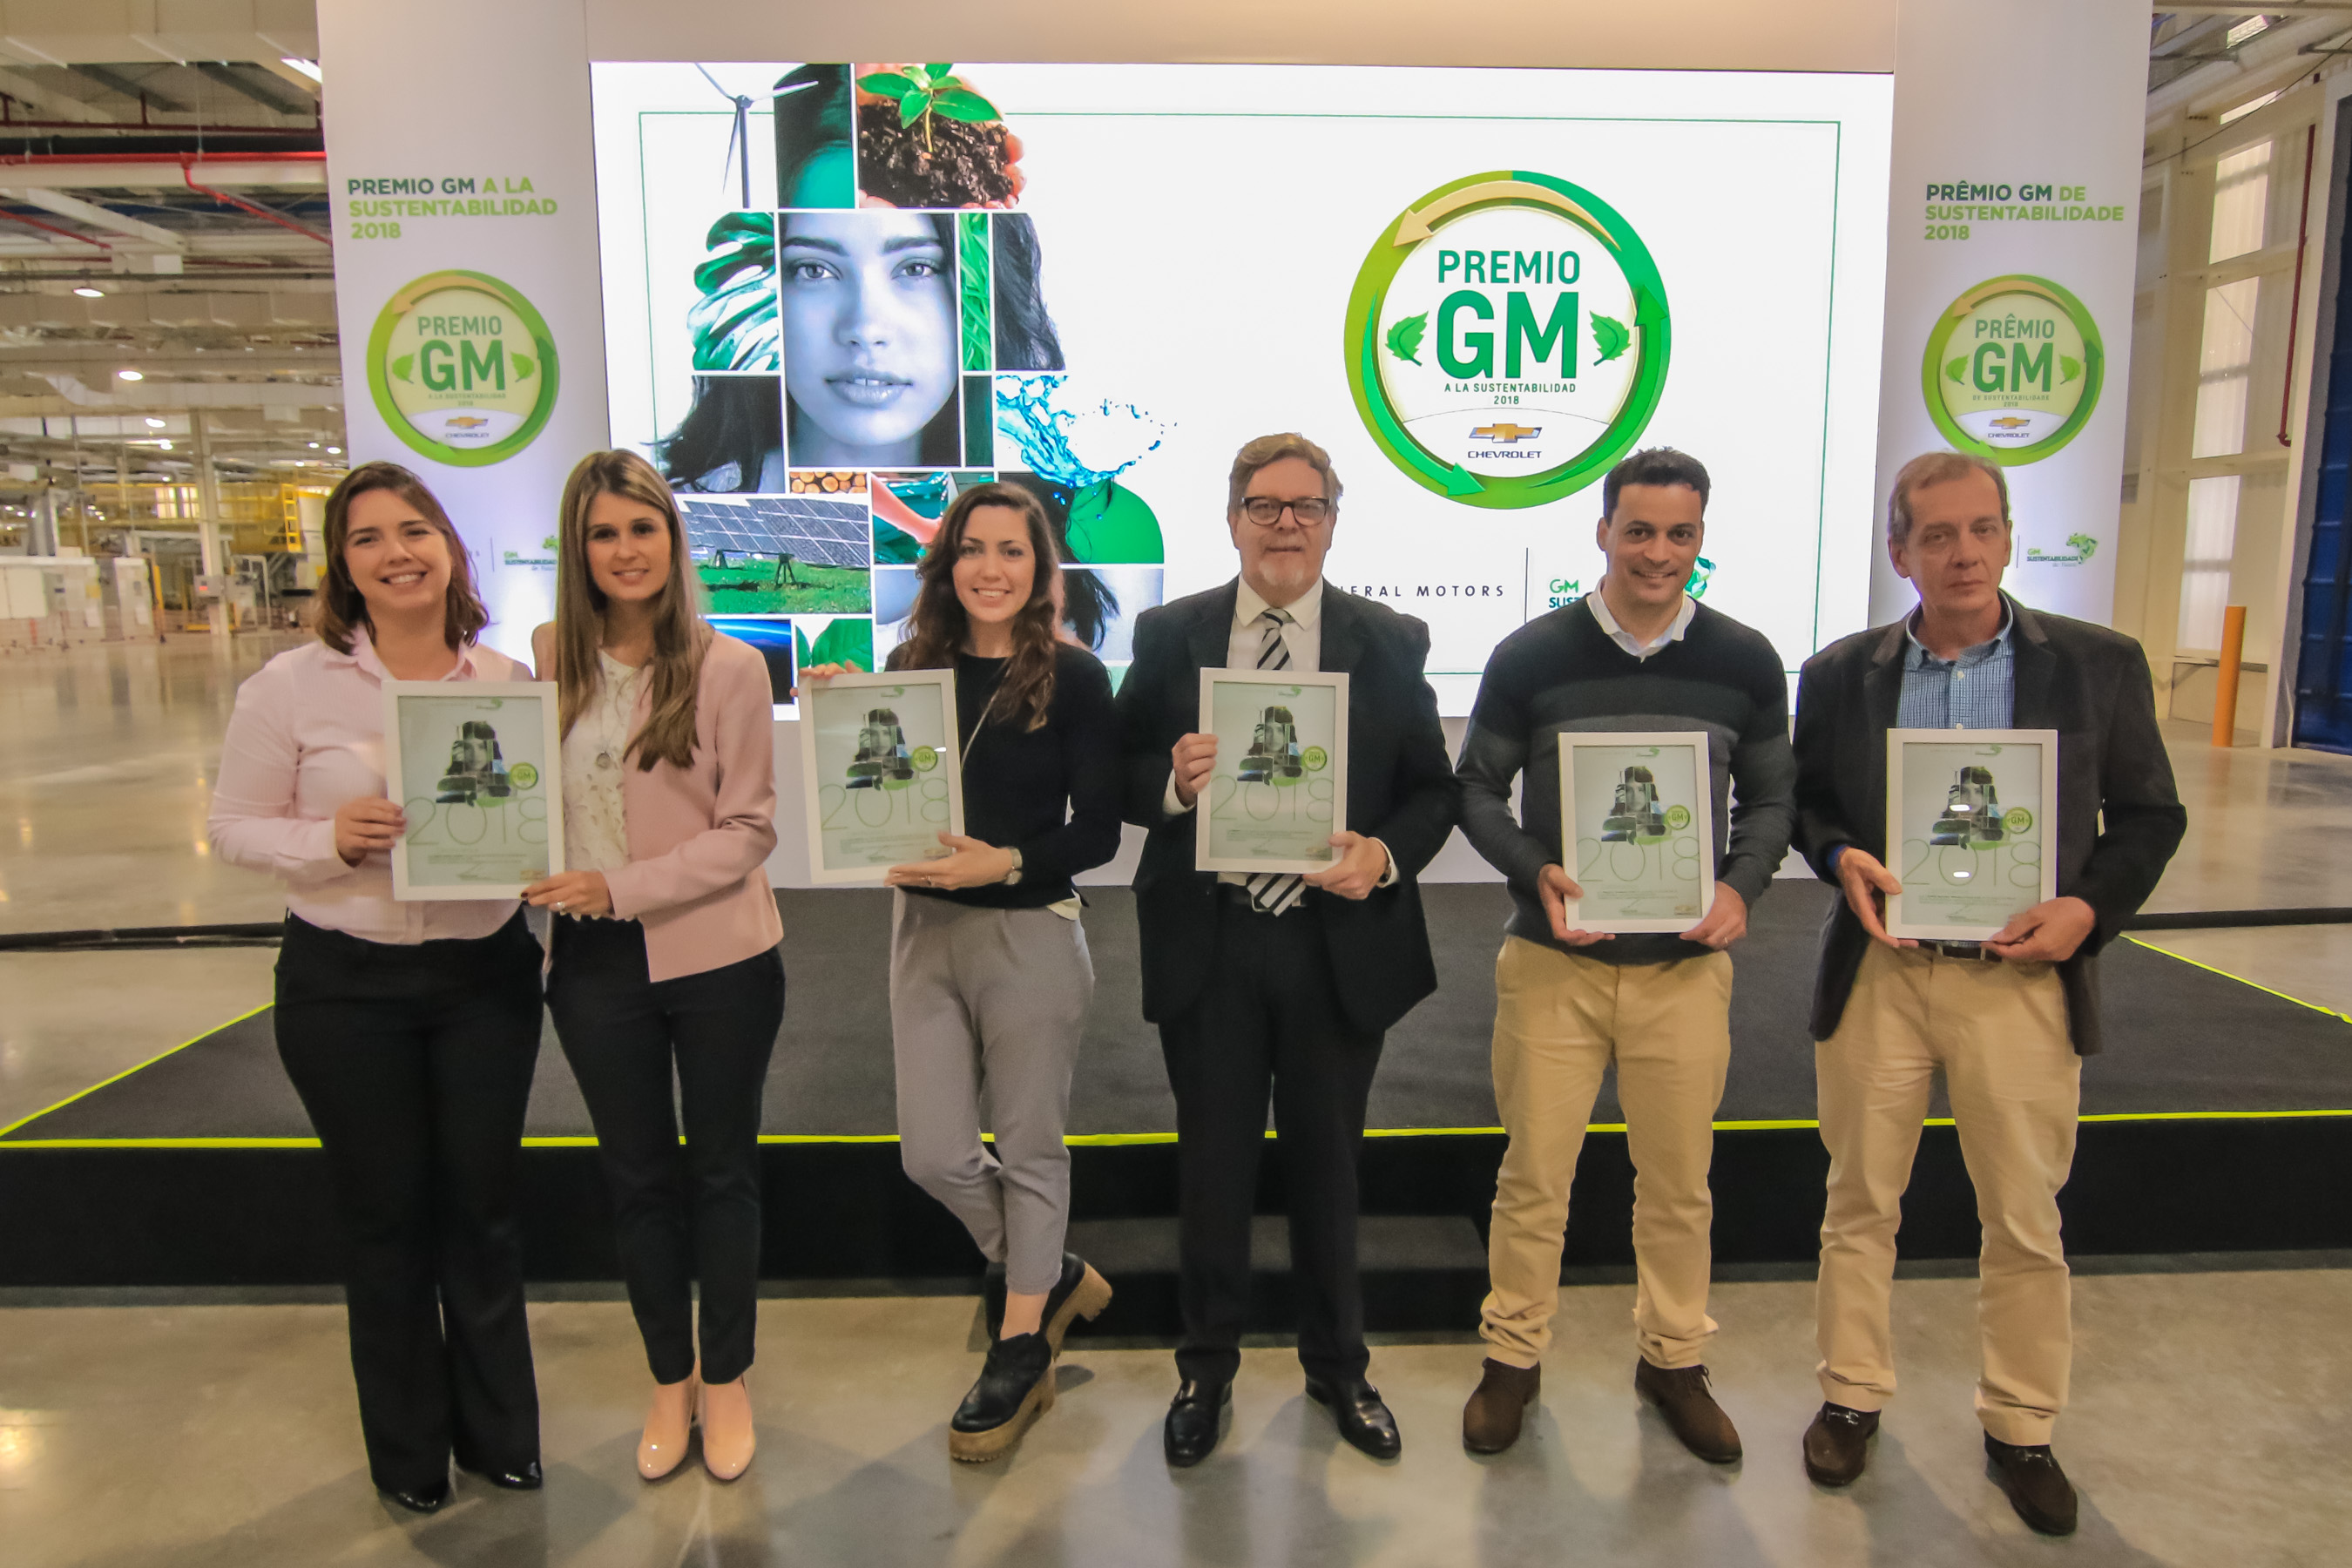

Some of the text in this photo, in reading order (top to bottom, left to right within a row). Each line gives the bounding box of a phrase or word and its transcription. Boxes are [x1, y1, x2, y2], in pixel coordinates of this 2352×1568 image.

[348, 176, 535, 195] PREMIO GM A LA
[1926, 180, 2086, 202] PRÊMIO GM DE
[348, 199, 558, 218] SUSTENTABILIDAD
[1925, 206, 2124, 221] SUSTENTABILIDADE
[351, 222, 402, 240] 2018
[1924, 225, 1970, 240] 2018
[1437, 250, 1580, 284] PREMIO
[417, 316, 502, 336] PREMIO
[1436, 289, 1579, 380] GM
[1975, 314, 2055, 340] PRÊMIO
[420, 340, 505, 392] GM
[1972, 342, 2054, 393] GM
[1444, 383, 1576, 392] A LA SUSTENTABILIDAD
[1493, 395, 1519, 404] 2018
[1416, 585, 1504, 598] MOTORS
[1549, 578, 1578, 593] GM
